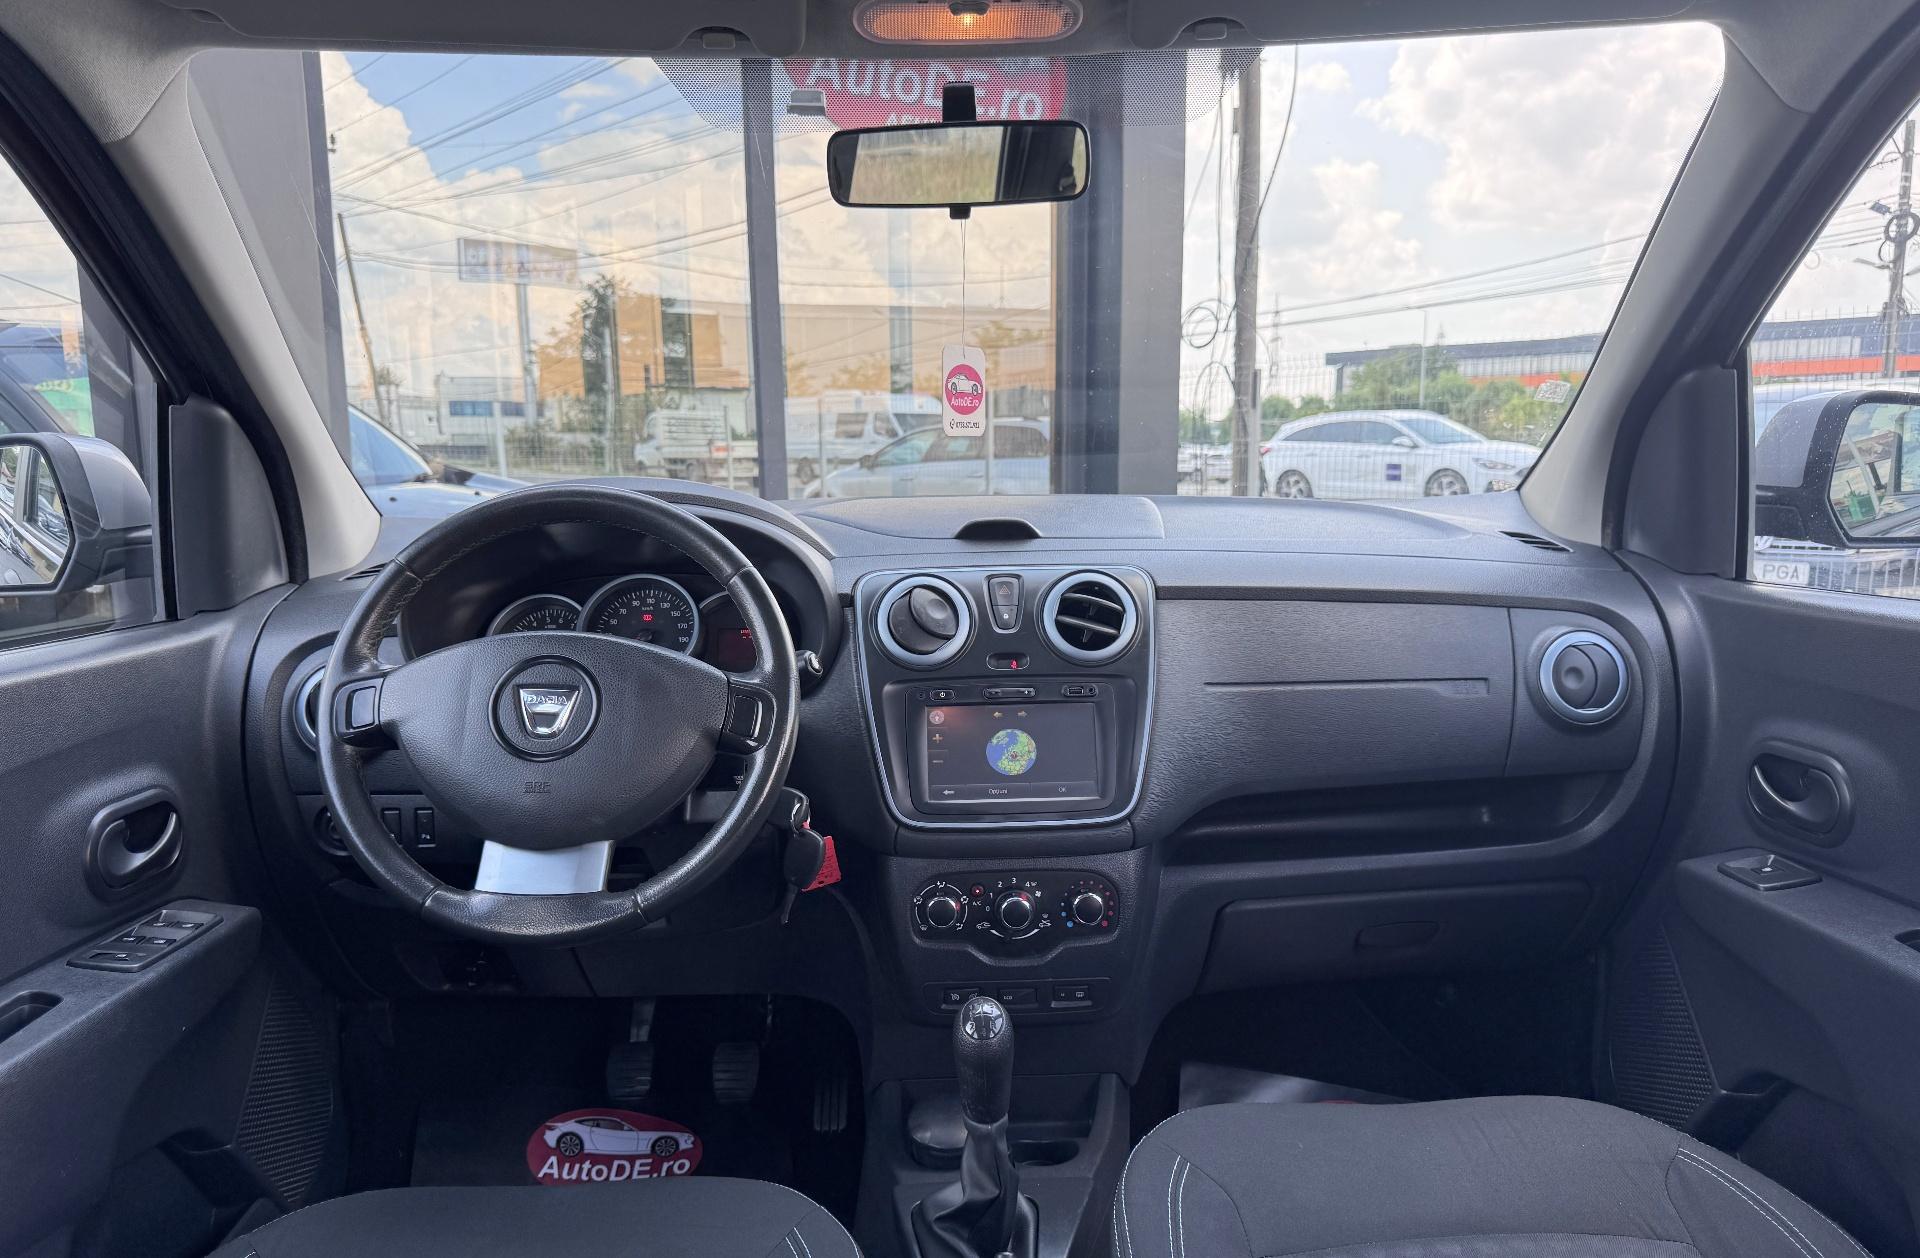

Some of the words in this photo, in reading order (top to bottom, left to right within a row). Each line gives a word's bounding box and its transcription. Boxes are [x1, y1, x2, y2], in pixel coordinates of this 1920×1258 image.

[1762, 563, 1800, 581] PGA
[526, 694, 568, 704] DACIA
[537, 1155, 691, 1182] AutoDE.ro
